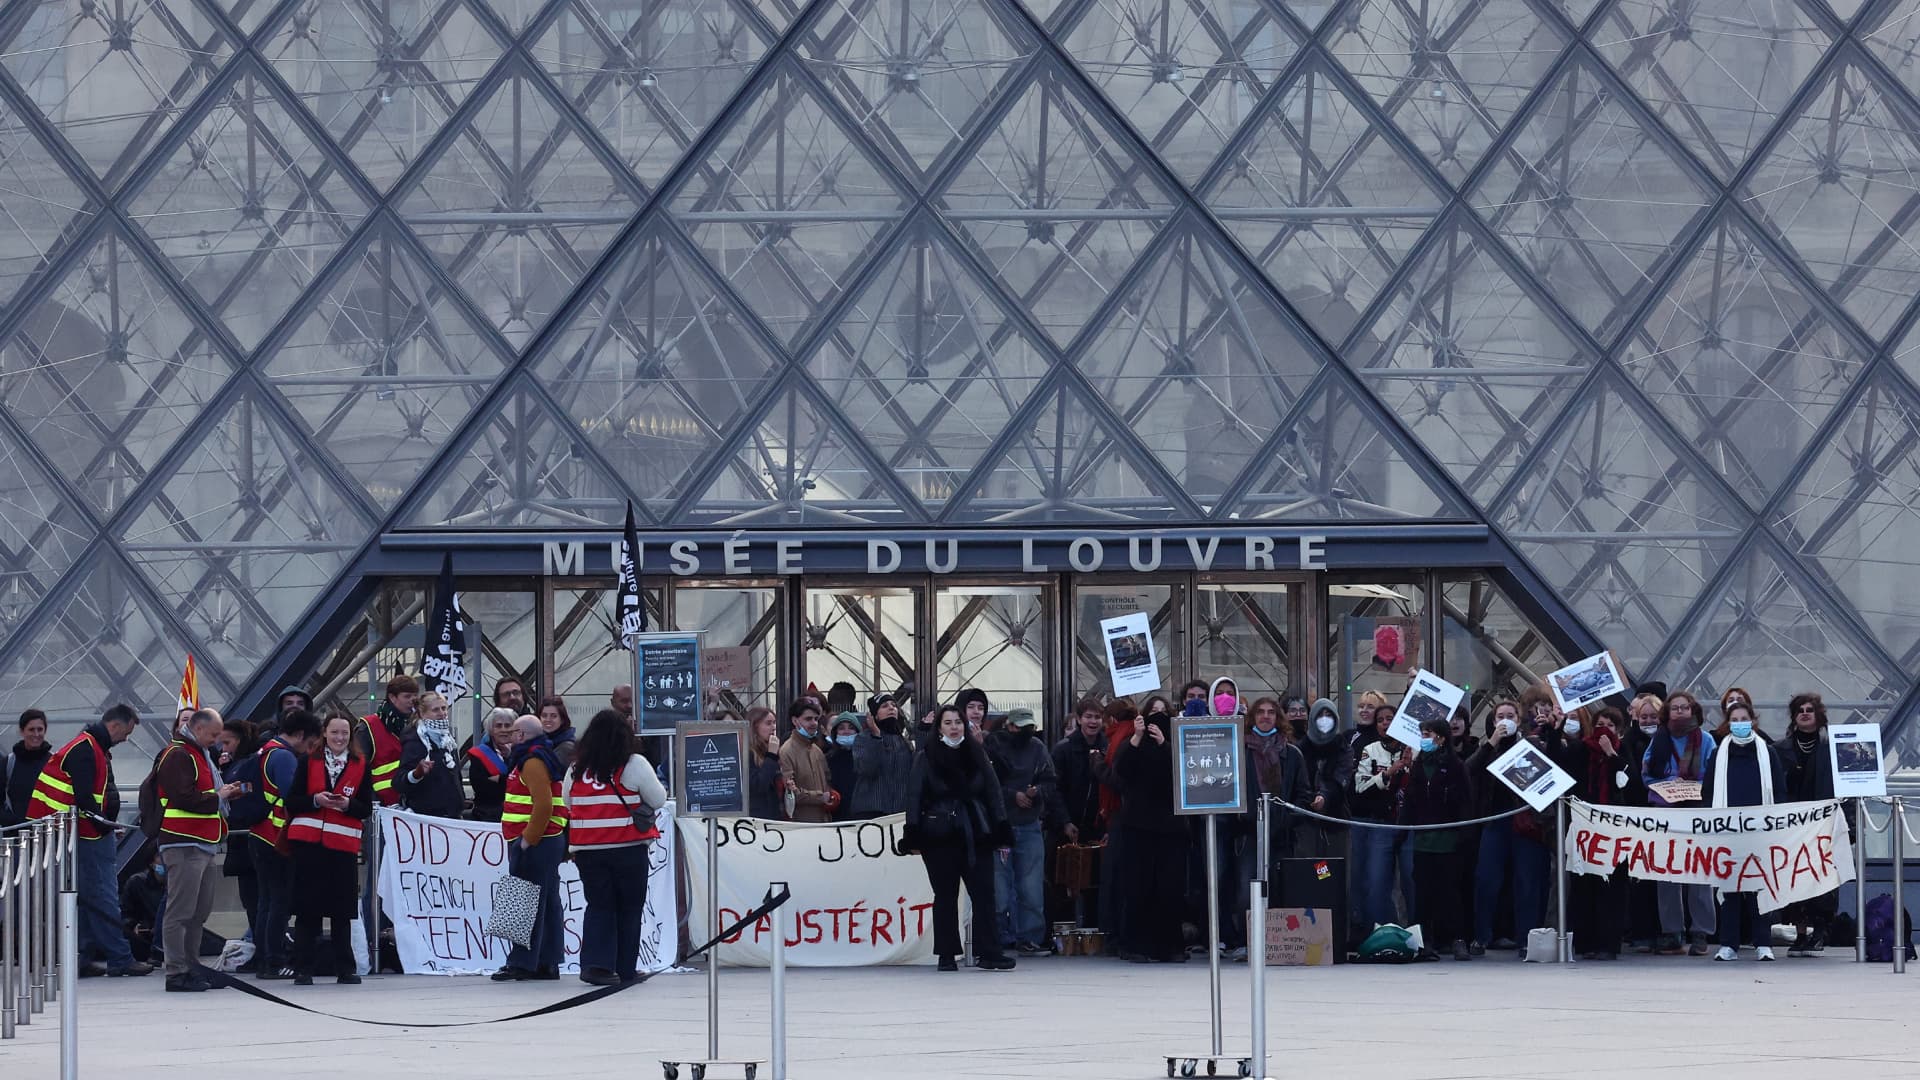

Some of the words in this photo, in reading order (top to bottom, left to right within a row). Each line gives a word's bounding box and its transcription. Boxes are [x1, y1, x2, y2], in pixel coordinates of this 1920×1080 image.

[543, 529, 804, 576] MUSÉE
[867, 539, 958, 575] DU
[1022, 536, 1328, 574] LOUVRE
[1590, 808, 1669, 834] FRENCH
[1763, 803, 1839, 831] SERVICE
[393, 817, 450, 866] DID
[463, 829, 506, 866] YO
[818, 822, 914, 863] JOU
[1316, 865, 1329, 875] cgt
[1737, 835, 1838, 901] APAR
[400, 871, 476, 912] FRENCH
[718, 897, 934, 947] D'AUSTÉRIT
